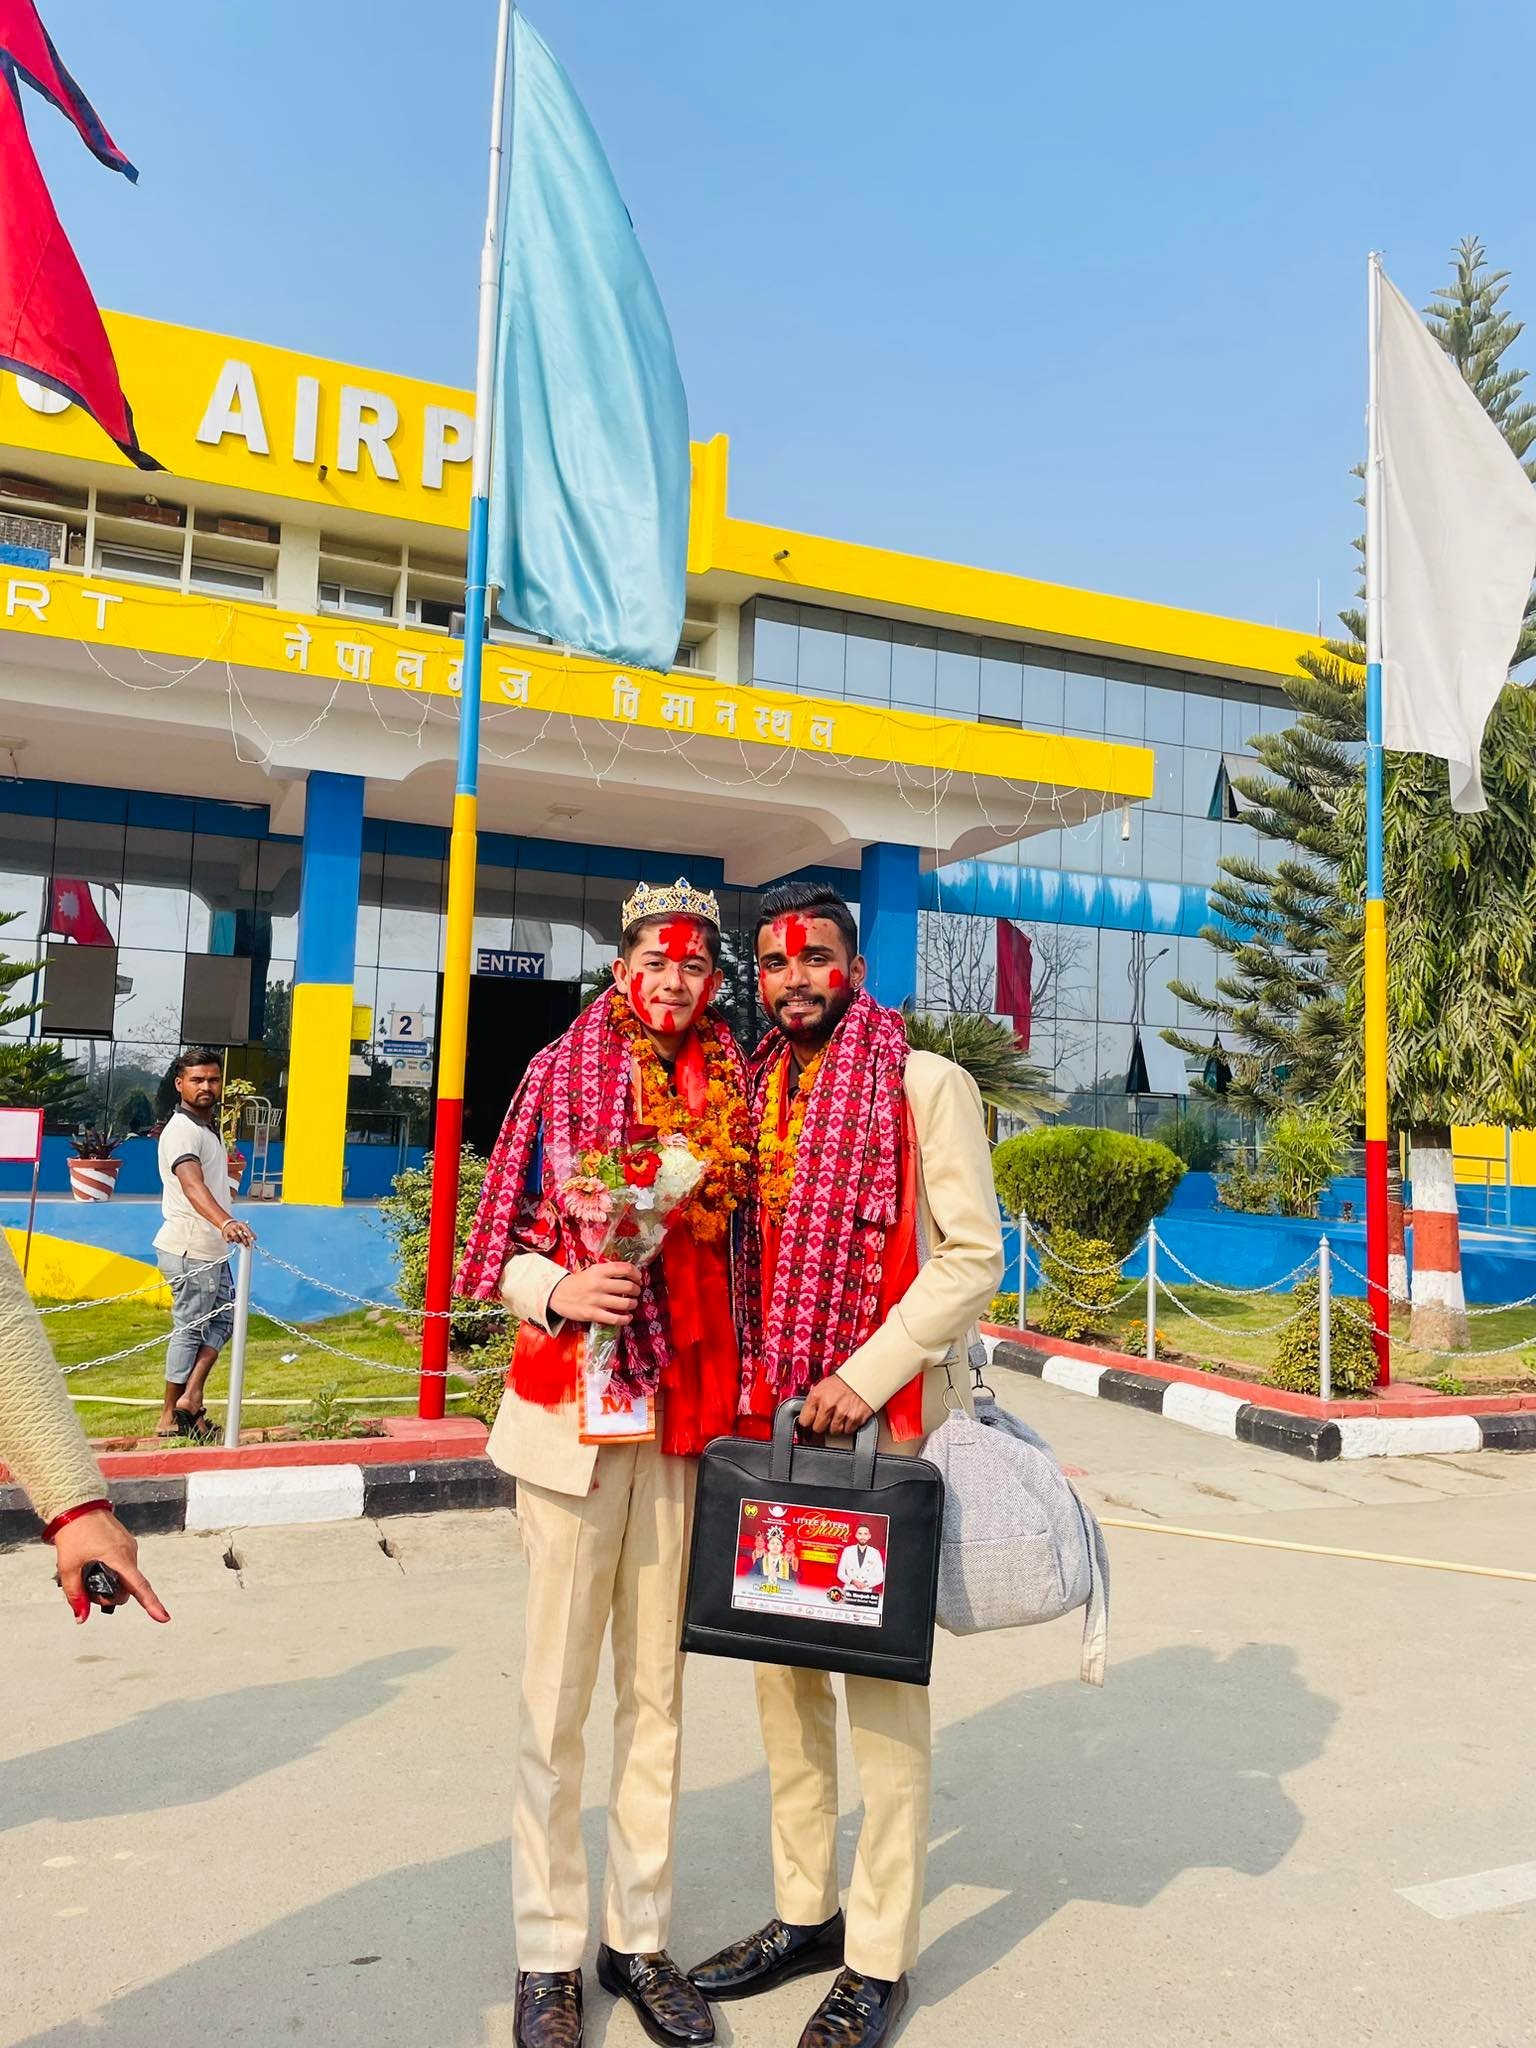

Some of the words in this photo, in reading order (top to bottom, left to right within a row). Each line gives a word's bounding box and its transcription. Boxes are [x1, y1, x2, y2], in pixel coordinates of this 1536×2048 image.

[195, 359, 475, 490] AIRP
[477, 953, 544, 974] ENTRY
[399, 1015, 412, 1035] 2
